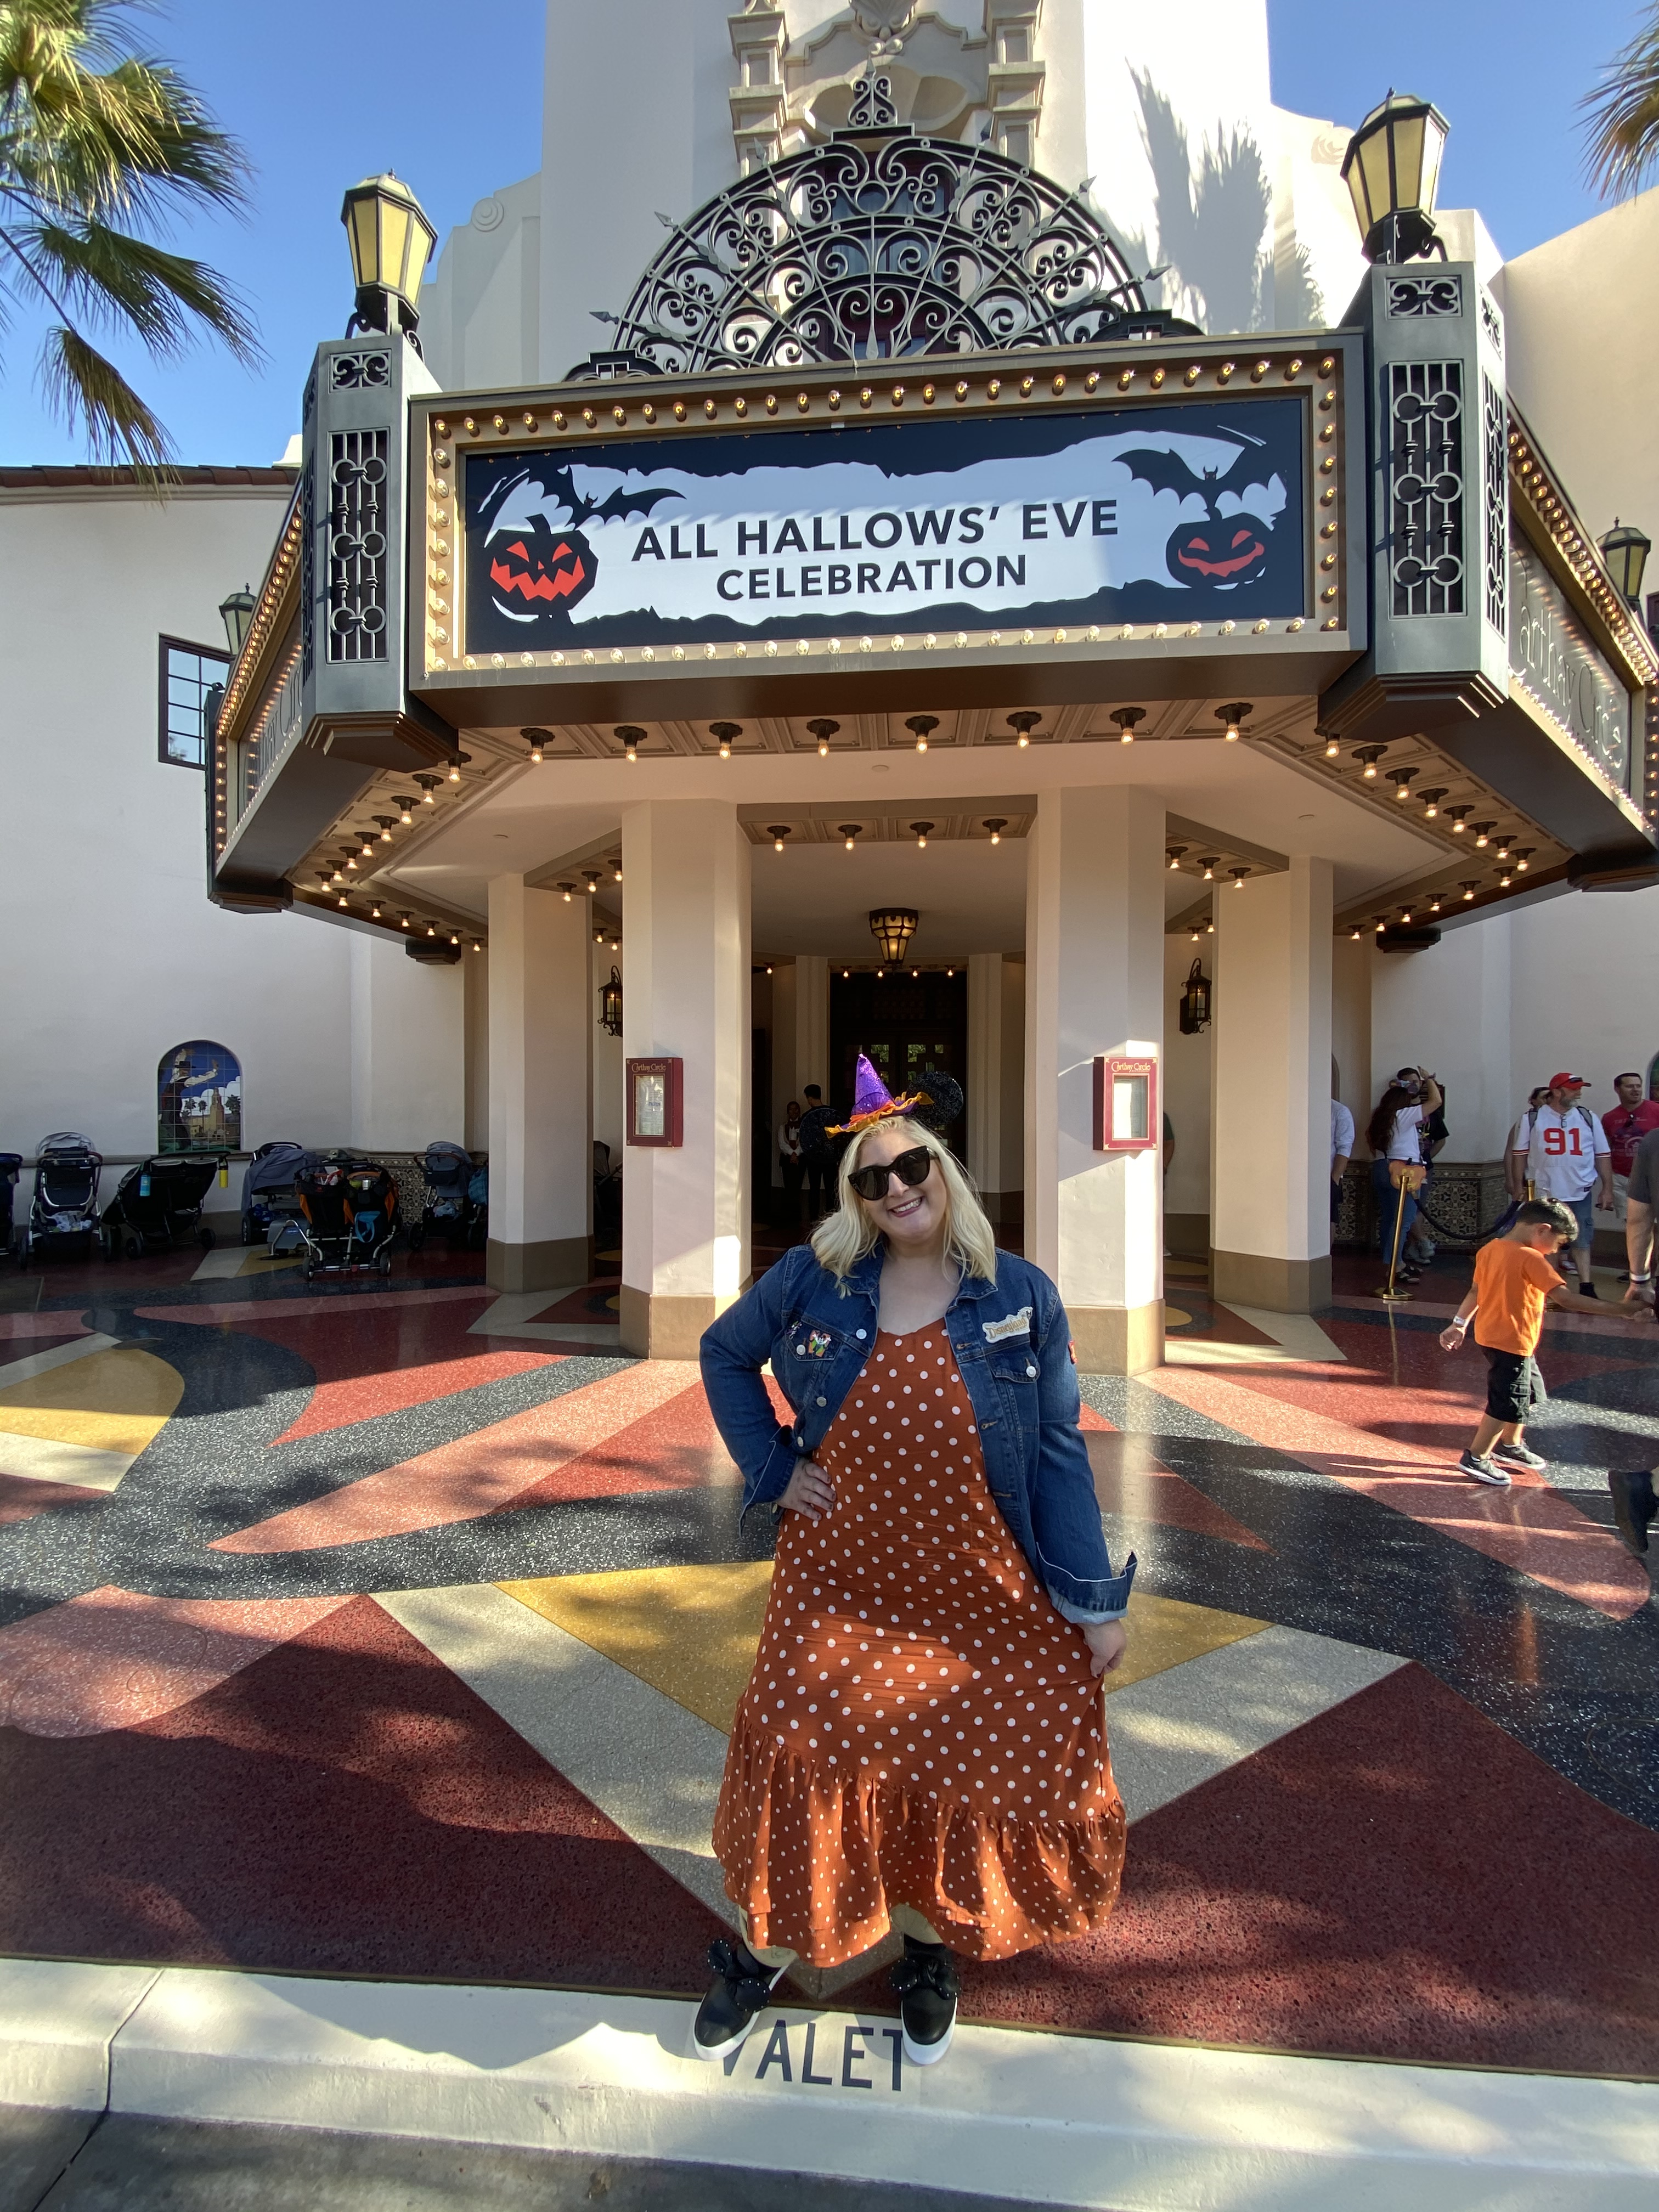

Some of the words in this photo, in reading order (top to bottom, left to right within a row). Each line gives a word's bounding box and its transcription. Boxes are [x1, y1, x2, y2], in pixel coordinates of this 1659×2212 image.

[631, 523, 718, 562] ALL
[738, 505, 1000, 556] HALLOWS’
[1022, 499, 1118, 540] EVE
[717, 554, 1026, 601] CELEBRATION
[1111, 1062, 1133, 1073] Carthay
[1134, 1062, 1151, 1070] Circle
[1543, 1127, 1583, 1156] 91
[985, 1317, 1026, 1339] Disneyland
